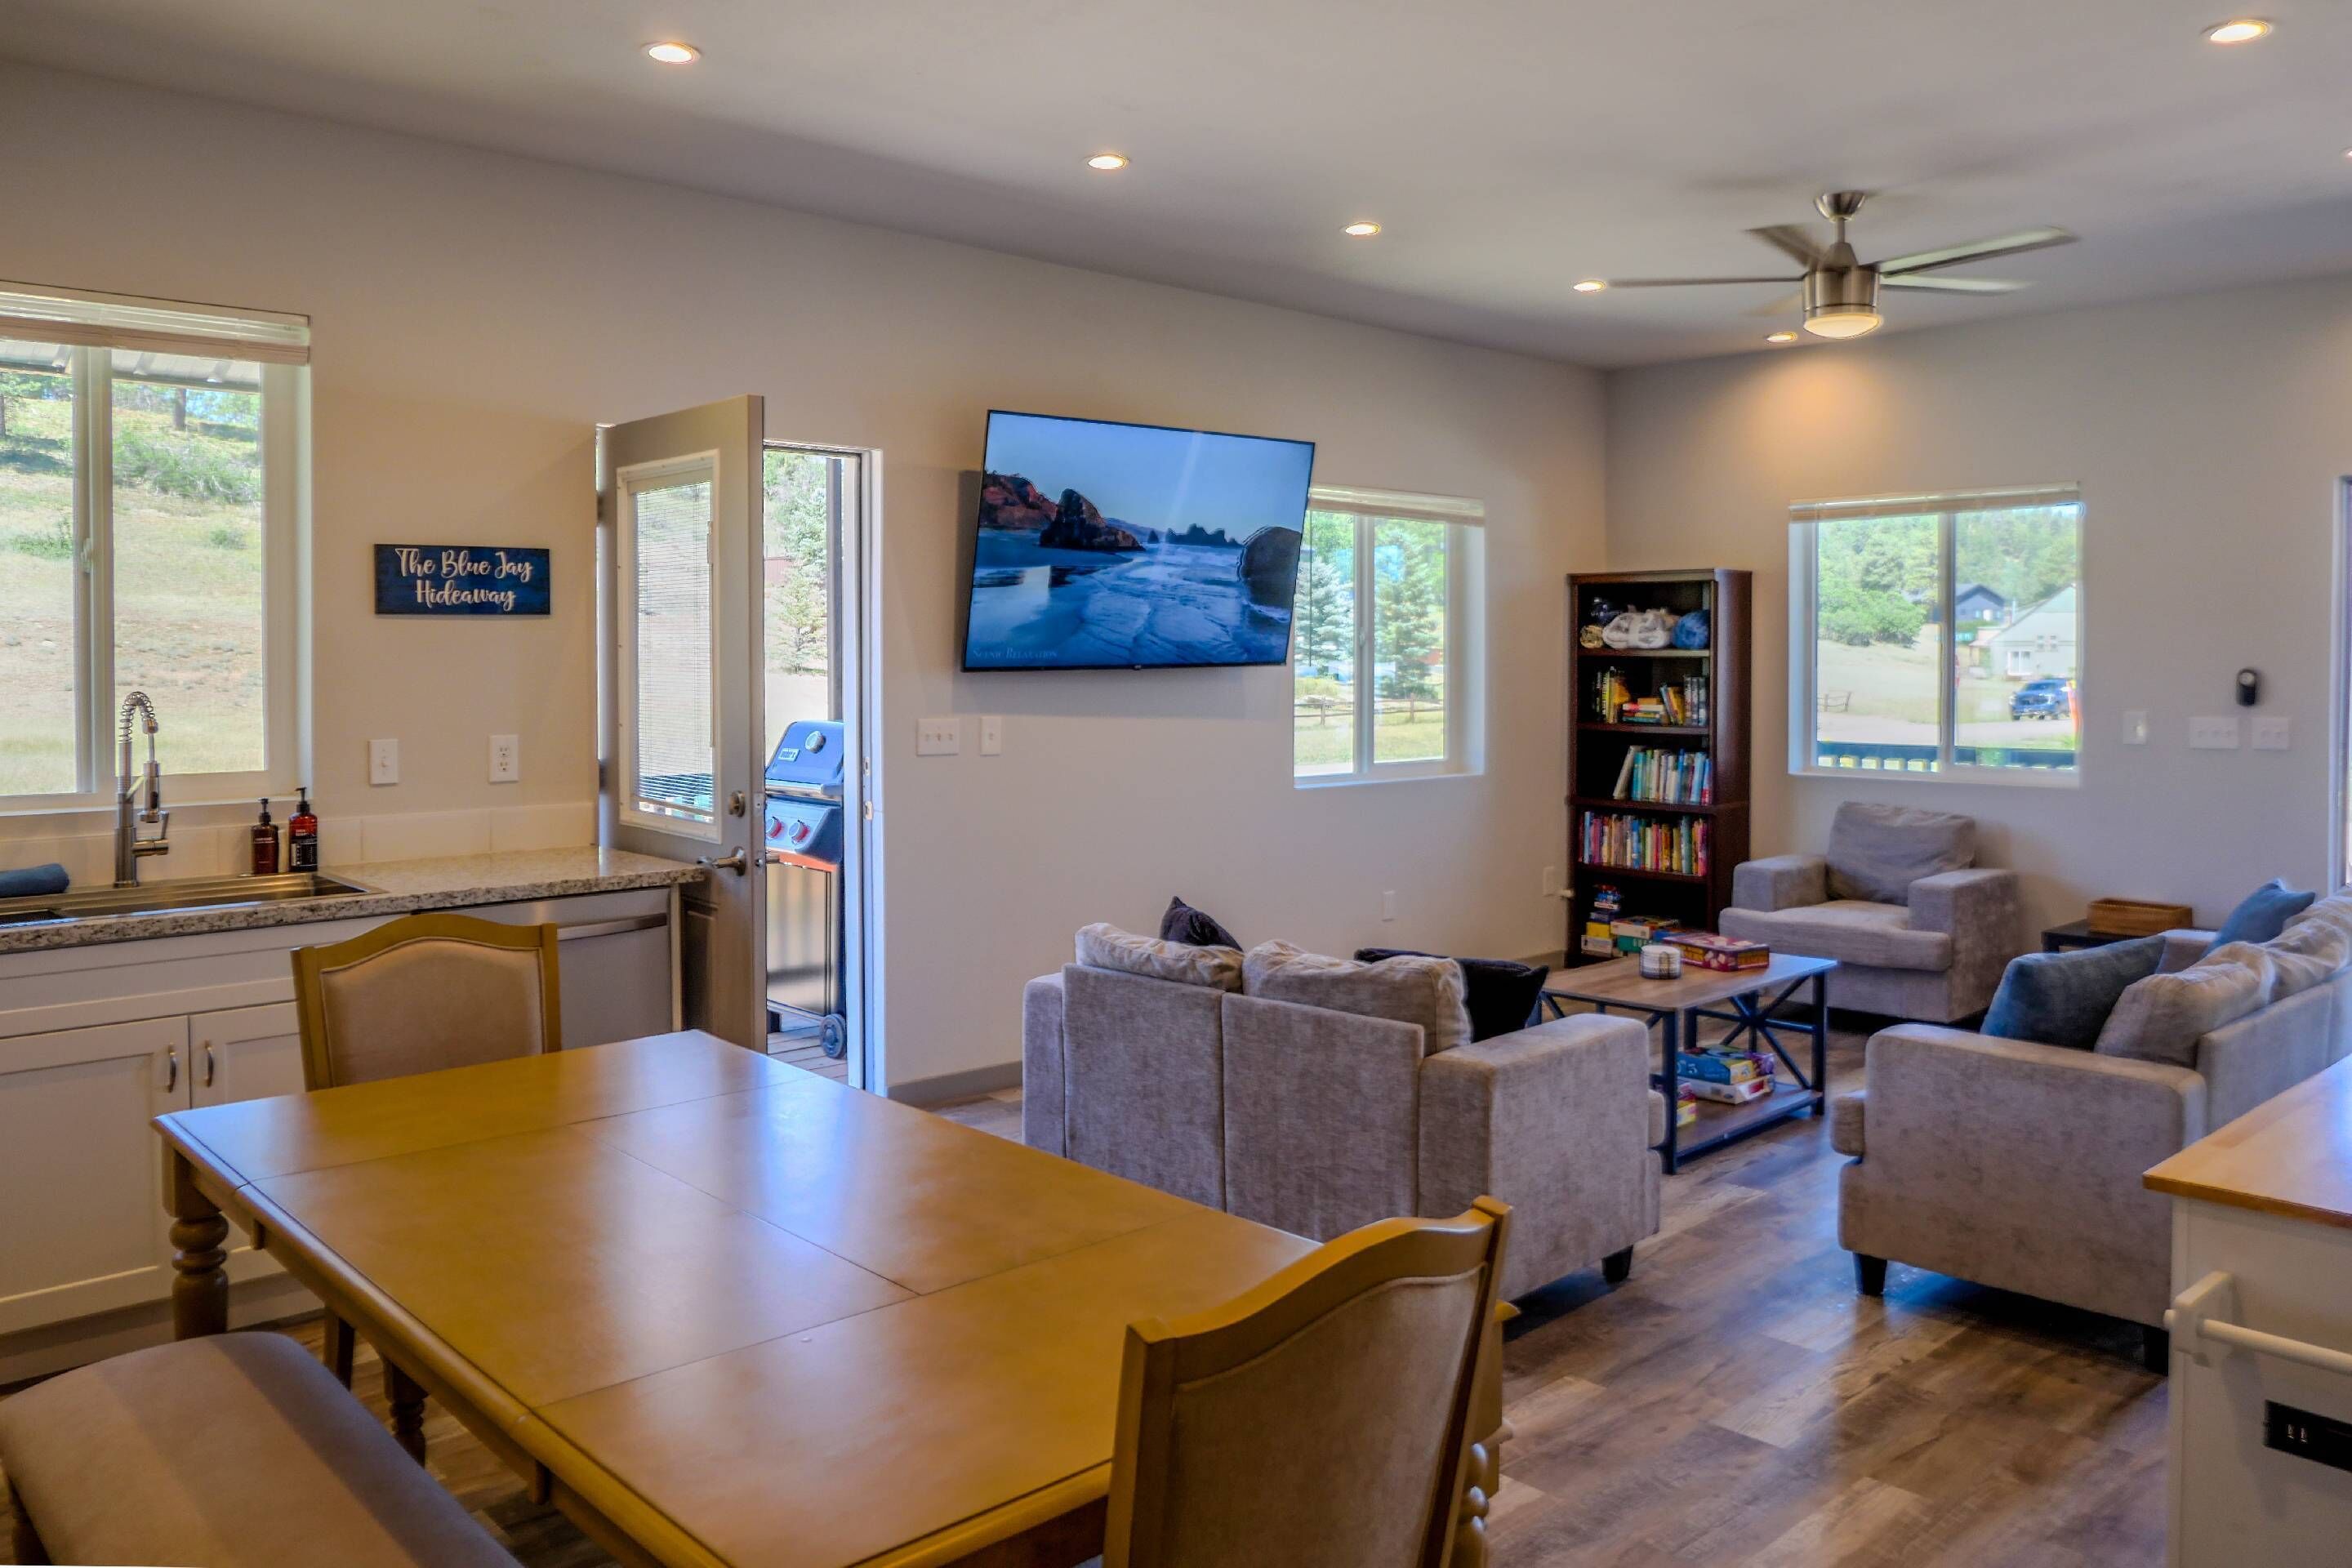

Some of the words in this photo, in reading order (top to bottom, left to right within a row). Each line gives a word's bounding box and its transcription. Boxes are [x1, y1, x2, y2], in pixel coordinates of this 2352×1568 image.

[395, 548, 435, 577] The
[441, 550, 490, 578] Blue
[494, 551, 534, 583] Jay
[415, 579, 517, 612] Hideaway
